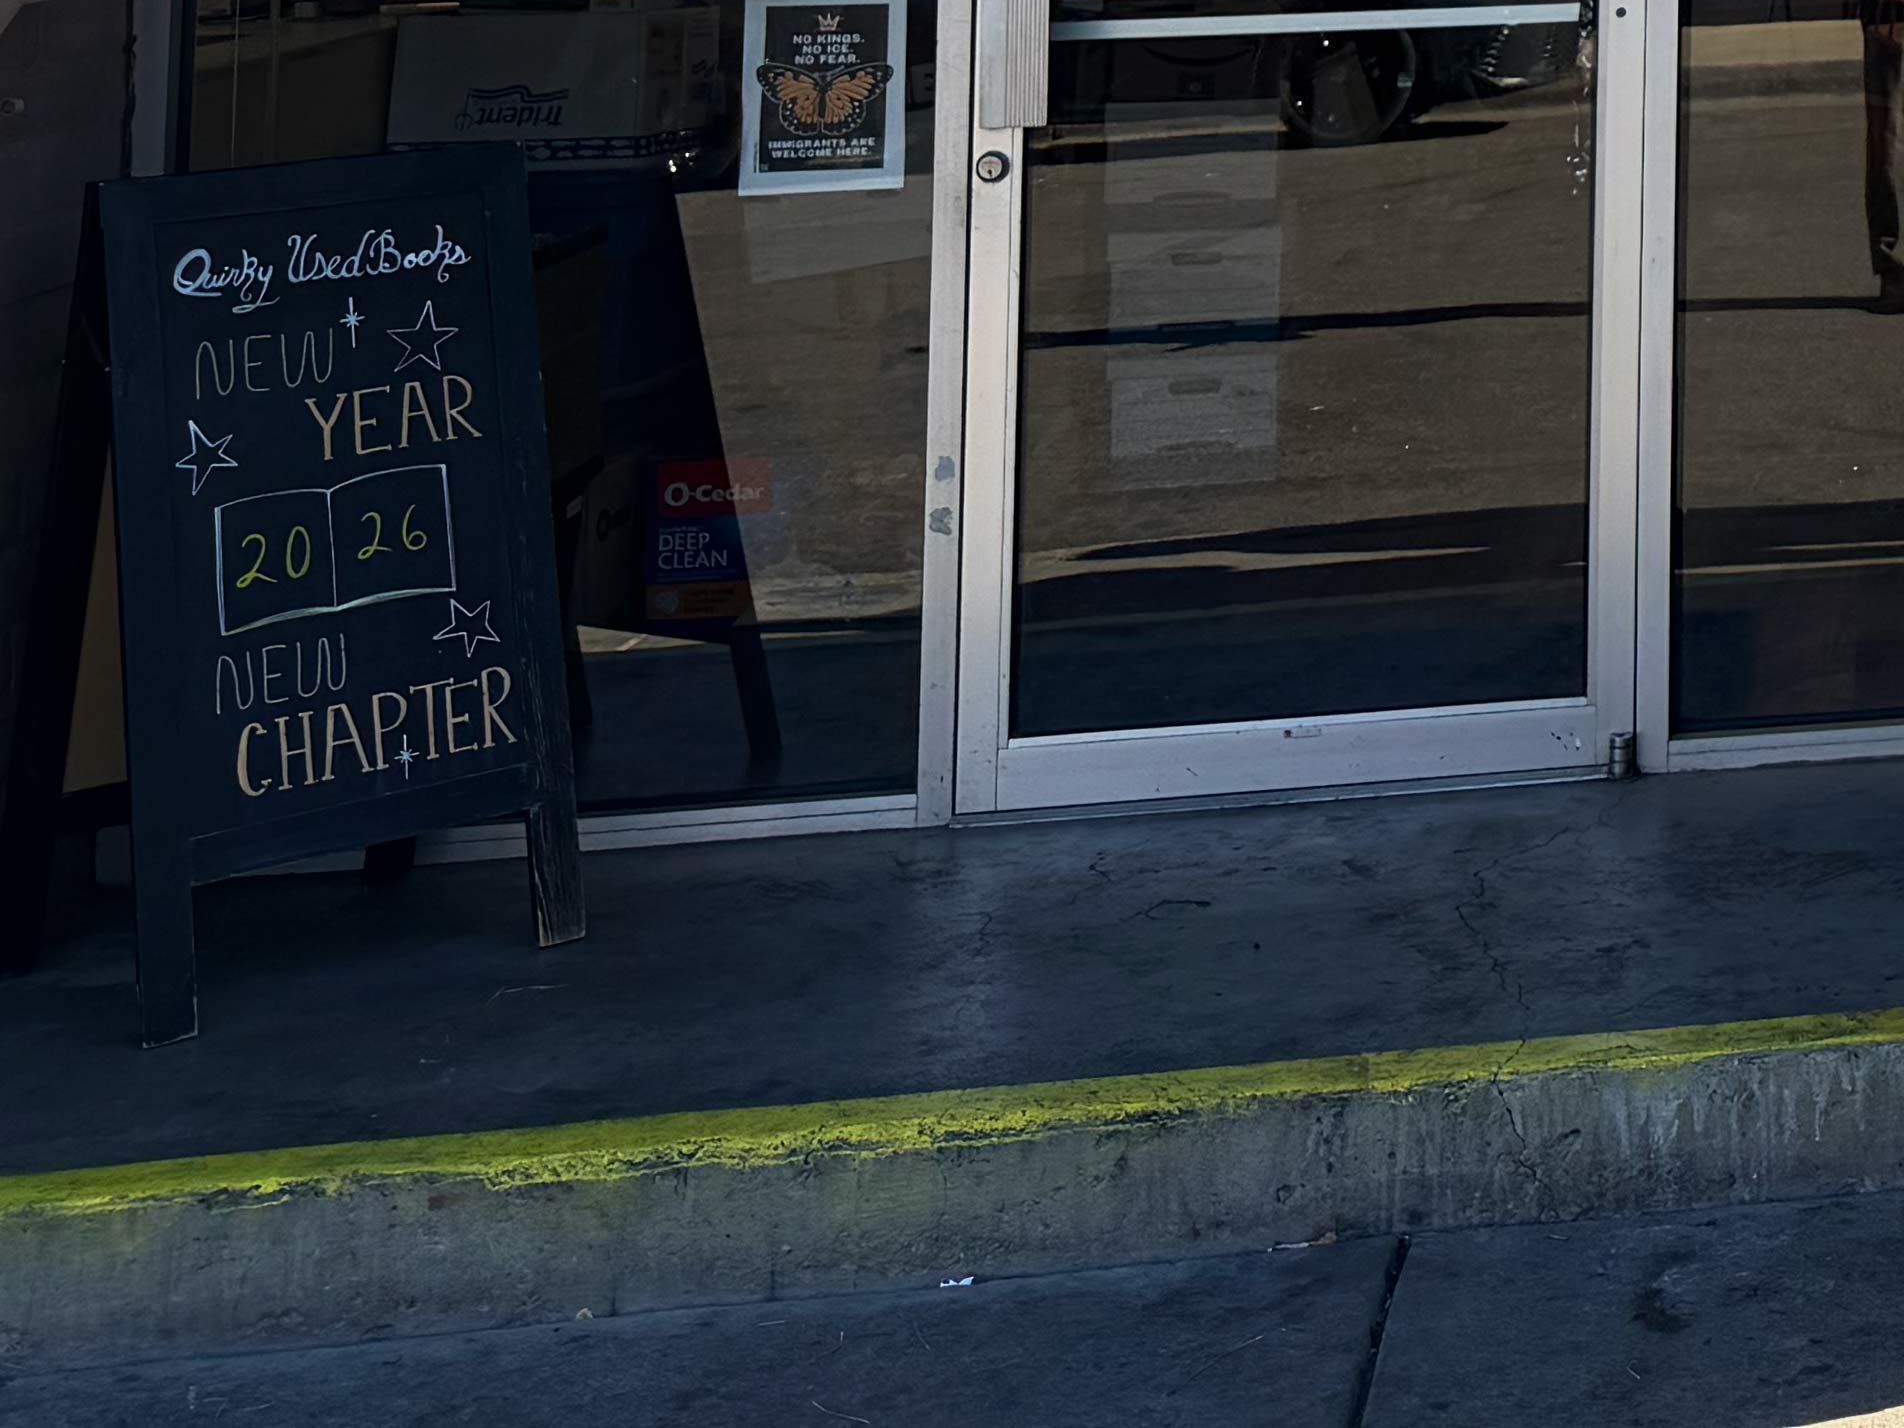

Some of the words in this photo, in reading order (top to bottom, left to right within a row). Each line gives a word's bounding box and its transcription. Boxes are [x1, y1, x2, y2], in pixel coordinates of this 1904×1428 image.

[792, 33, 812, 44] NO
[817, 33, 865, 44] KINGS.
[802, 44, 821, 54] NO
[827, 44, 854, 54] ICE.
[794, 54, 814, 65] NO
[820, 54, 861, 64] FEAR.
[768, 138, 846, 150] IMMIGRANTS
[850, 137, 876, 147] ARE
[771, 147, 832, 159] WELCOME
[837, 146, 872, 156] HERE.
[173, 247, 279, 313] Quirky
[287, 234, 368, 282] Used
[369, 225, 472, 283] Books
[194, 329, 335, 399] NEW
[303, 374, 484, 462] YEAR
[663, 480, 764, 507] O-Cedar
[235, 526, 311, 590] 20
[357, 503, 429, 561] 26
[658, 531, 710, 551] DEEP
[657, 549, 728, 570] CLEAN
[213, 633, 348, 716] NEW
[235, 666, 518, 798] CHAPTER
